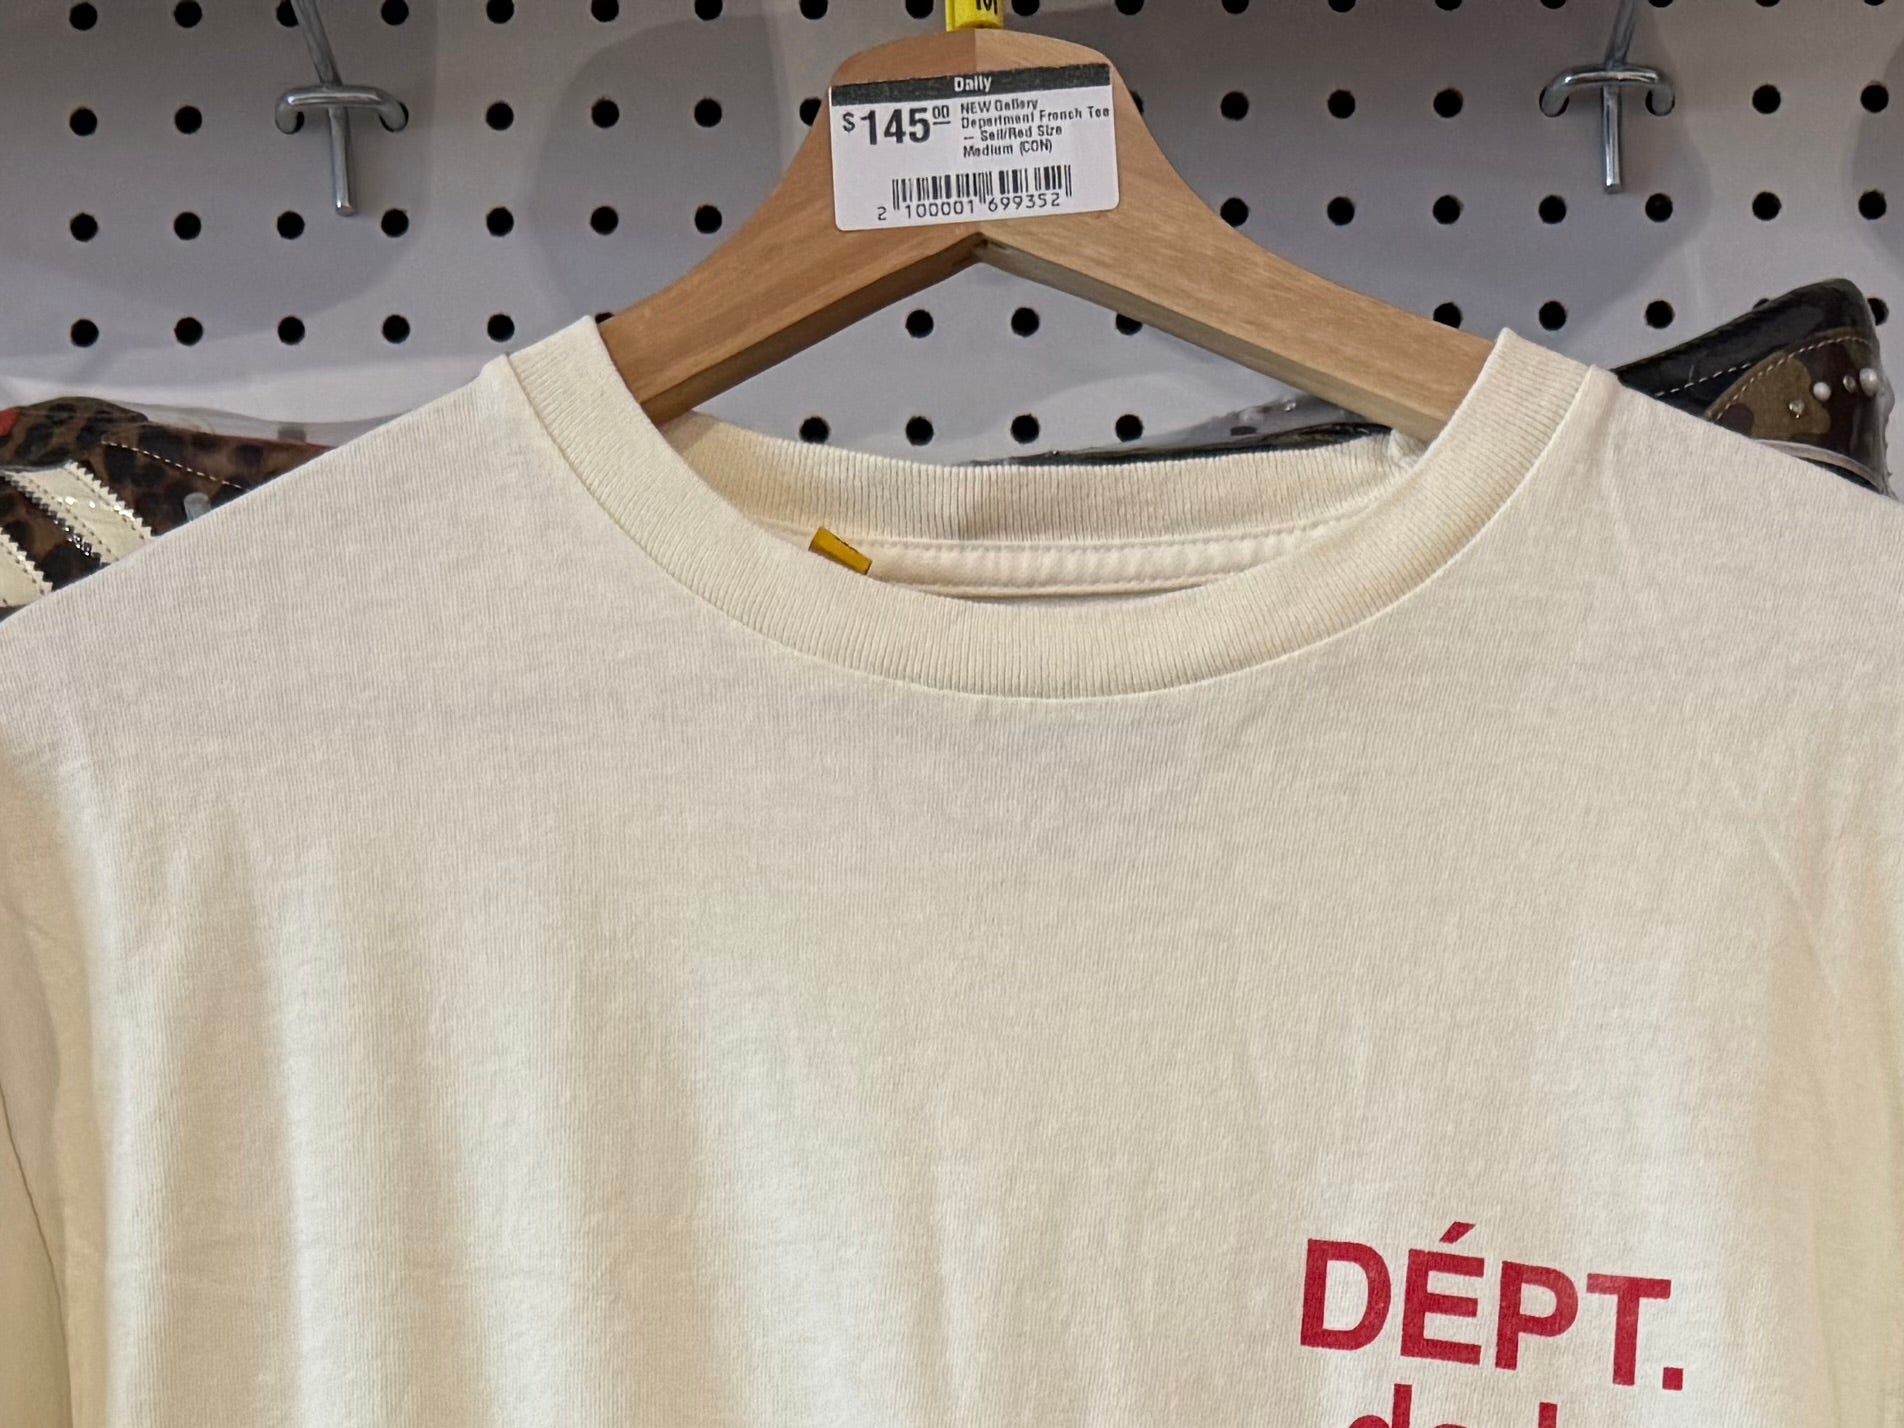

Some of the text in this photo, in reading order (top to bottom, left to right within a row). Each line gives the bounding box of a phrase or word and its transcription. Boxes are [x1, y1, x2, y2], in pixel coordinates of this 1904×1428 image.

[954, 75, 993, 93] Daily
[961, 100, 991, 115] NEW
[961, 105, 1110, 130] Department French Tee
[963, 139, 1053, 158] Medium (CON)
[904, 199, 975, 220] 100001
[988, 192, 1061, 213] 699352
[1300, 1221, 1684, 1391] DÉPT.
